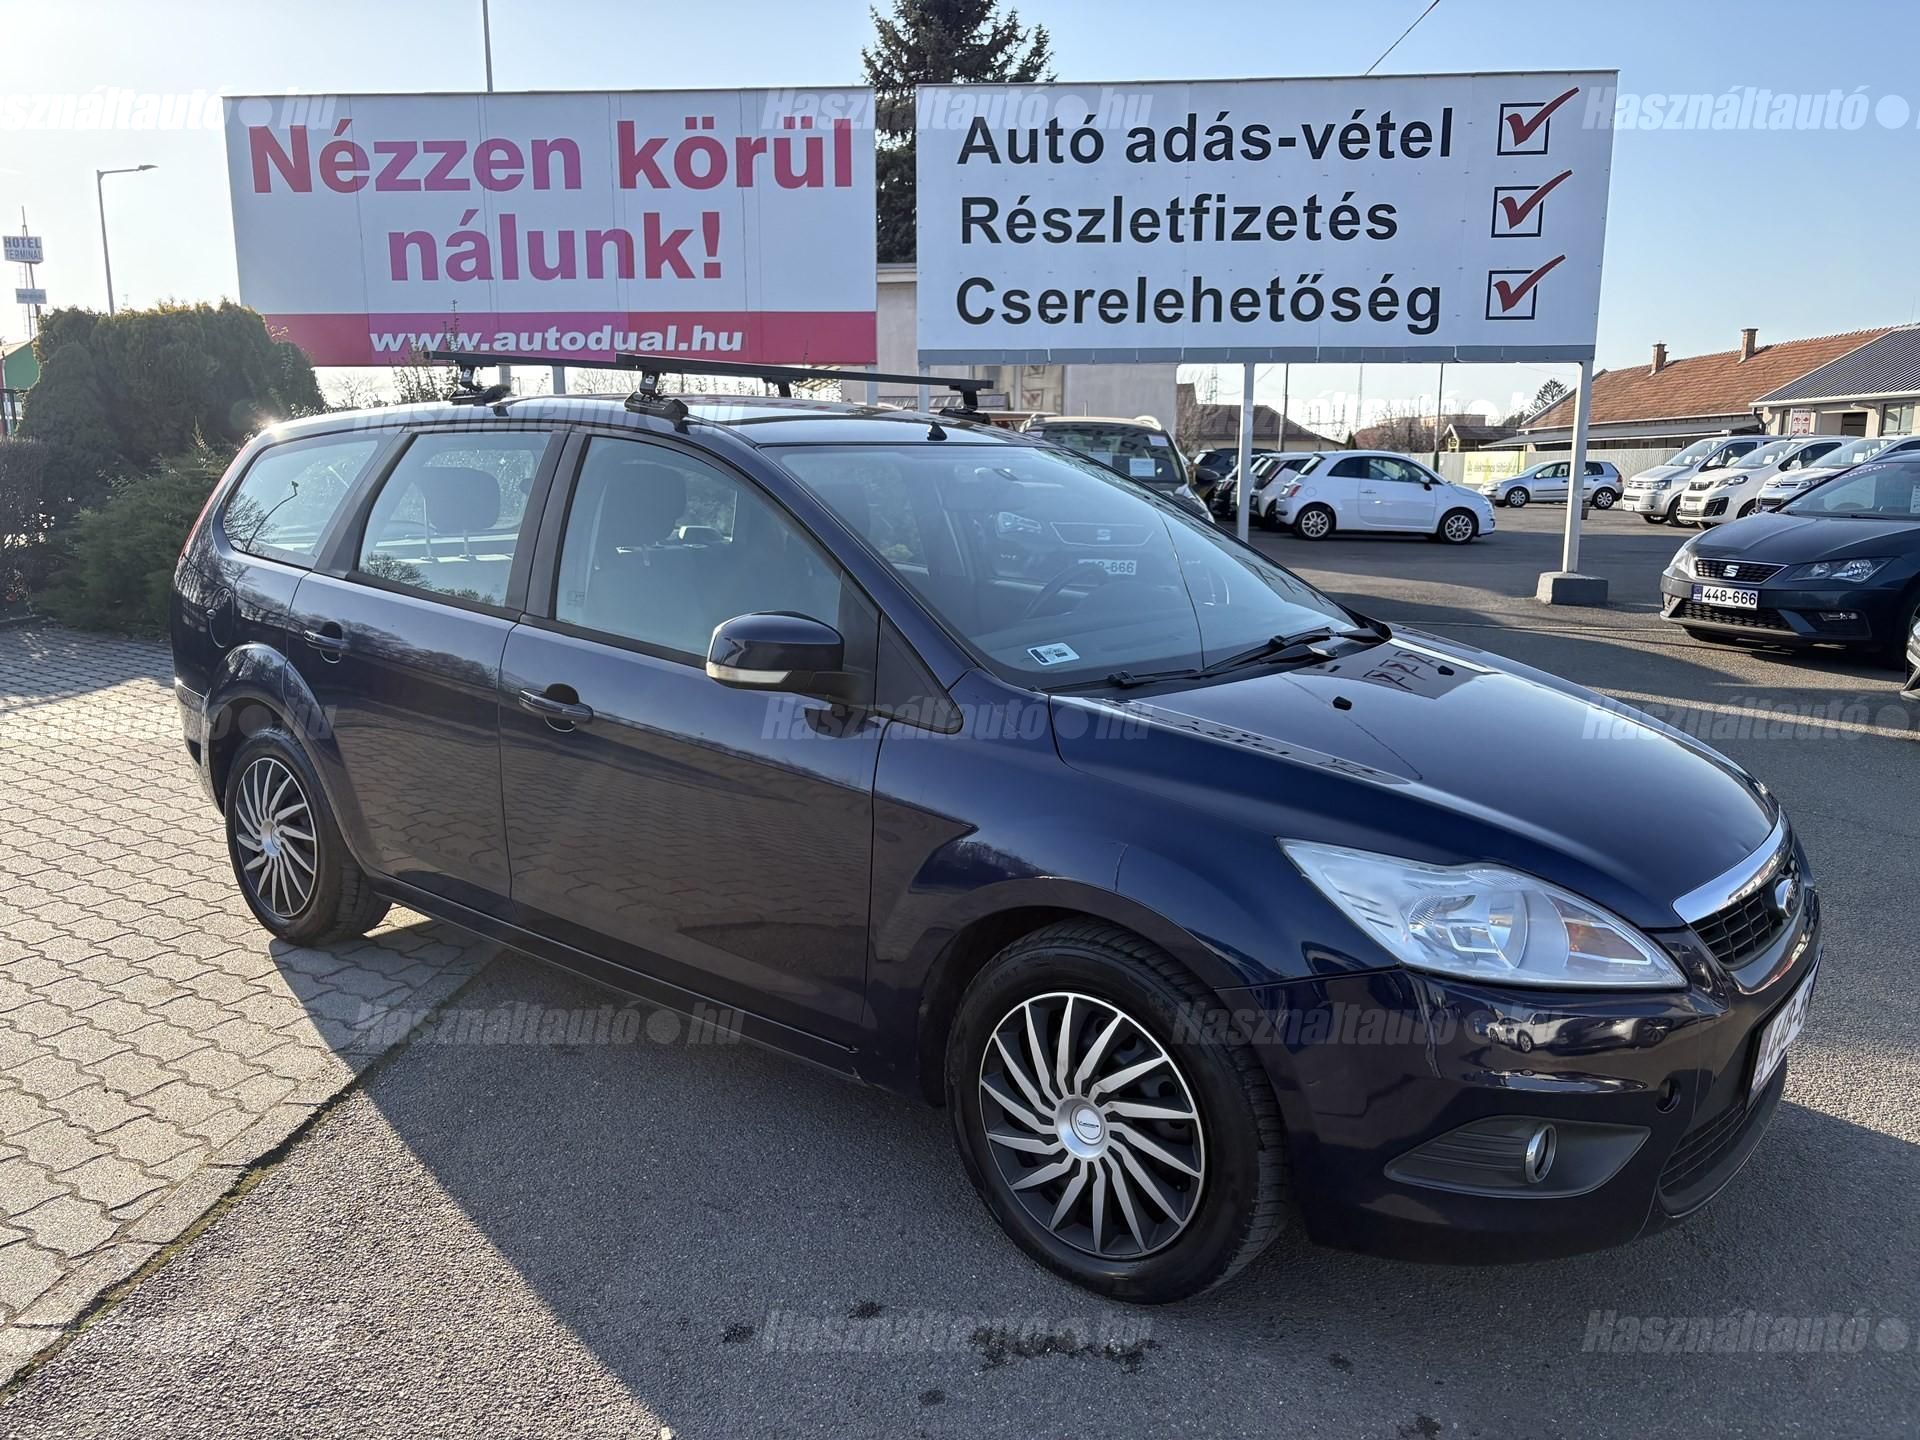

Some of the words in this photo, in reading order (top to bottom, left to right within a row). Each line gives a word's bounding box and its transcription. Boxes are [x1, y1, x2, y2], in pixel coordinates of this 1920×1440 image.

[249, 118, 582, 194] Nézzen
[617, 116, 853, 190] körül
[957, 114, 1104, 165] Autó
[1125, 107, 1453, 163] adás-vétel
[4, 236, 42, 249] HOTEL
[962, 191, 1398, 244] Részletfizetés
[5, 248, 43, 260] TERMINAL
[388, 209, 722, 282] nálunk!
[956, 273, 1441, 334] Cserelehetőség
[370, 325, 744, 352] www.autodual.hu
[1704, 588, 1757, 606] 448-666
